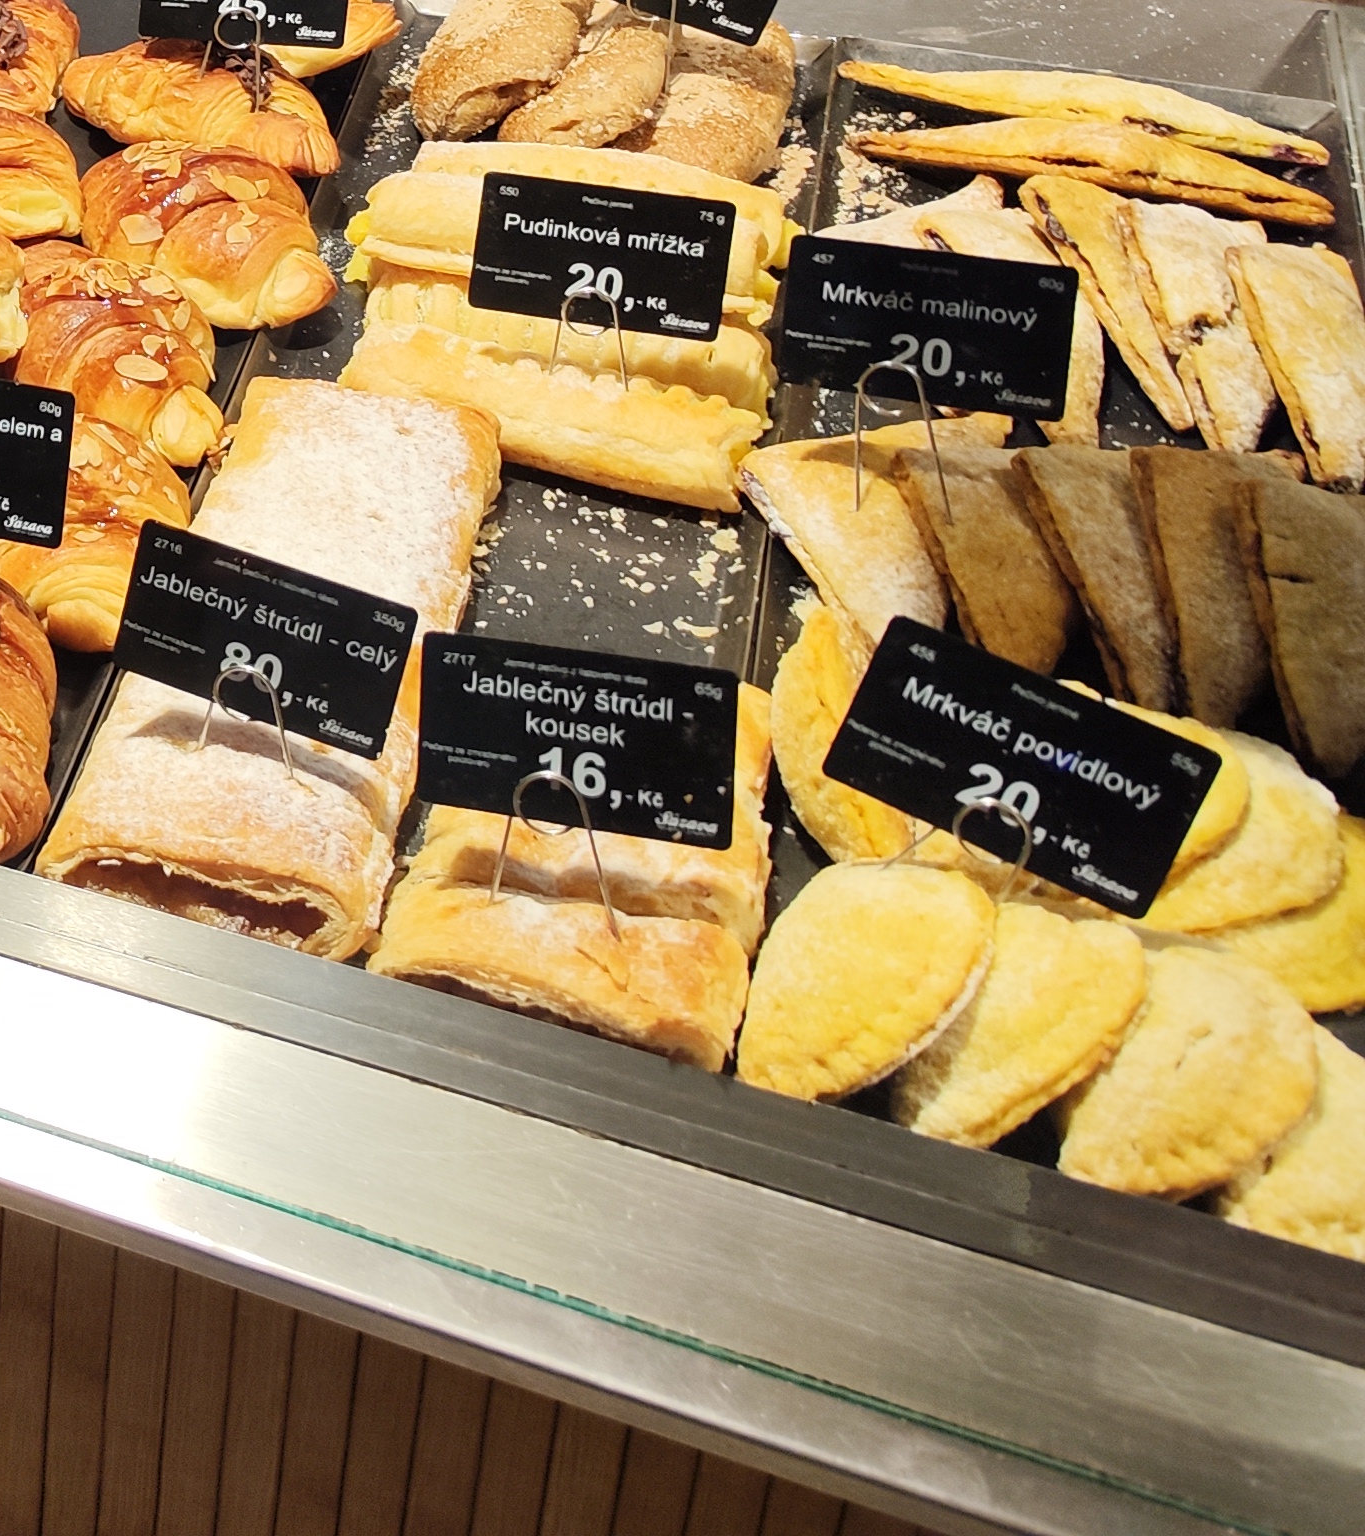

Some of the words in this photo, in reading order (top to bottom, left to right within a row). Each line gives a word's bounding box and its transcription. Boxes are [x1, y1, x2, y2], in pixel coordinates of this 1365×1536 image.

[285, 12, 303, 25] Kč
[499, 185, 519, 197] 550
[504, 213, 620, 247] Pudinková
[627, 231, 705, 258] mřížka
[646, 296, 667, 311] Kč
[822, 280, 914, 312] Mrkváč
[921, 297, 1038, 332] malinový
[980, 370, 1003, 386] Kč
[39, 401, 62, 417] 60g
[50, 427, 63, 443] a
[154, 537, 183, 555] 2716
[372, 610, 406, 633] 350g
[140, 565, 248, 621] Jablečný
[252, 603, 324, 644] štrúdl
[345, 638, 399, 673] celý
[442, 652, 476, 666] 2717
[306, 694, 330, 714] Kč
[463, 670, 586, 713] Jablečný
[594, 688, 674, 722] štrúdl
[525, 711, 626, 748] kousek
[901, 675, 1012, 743] Mrkváč
[1012, 730, 1162, 812] povidlový
[638, 789, 664, 808] Kč
[1061, 834, 1092, 860] Kč
